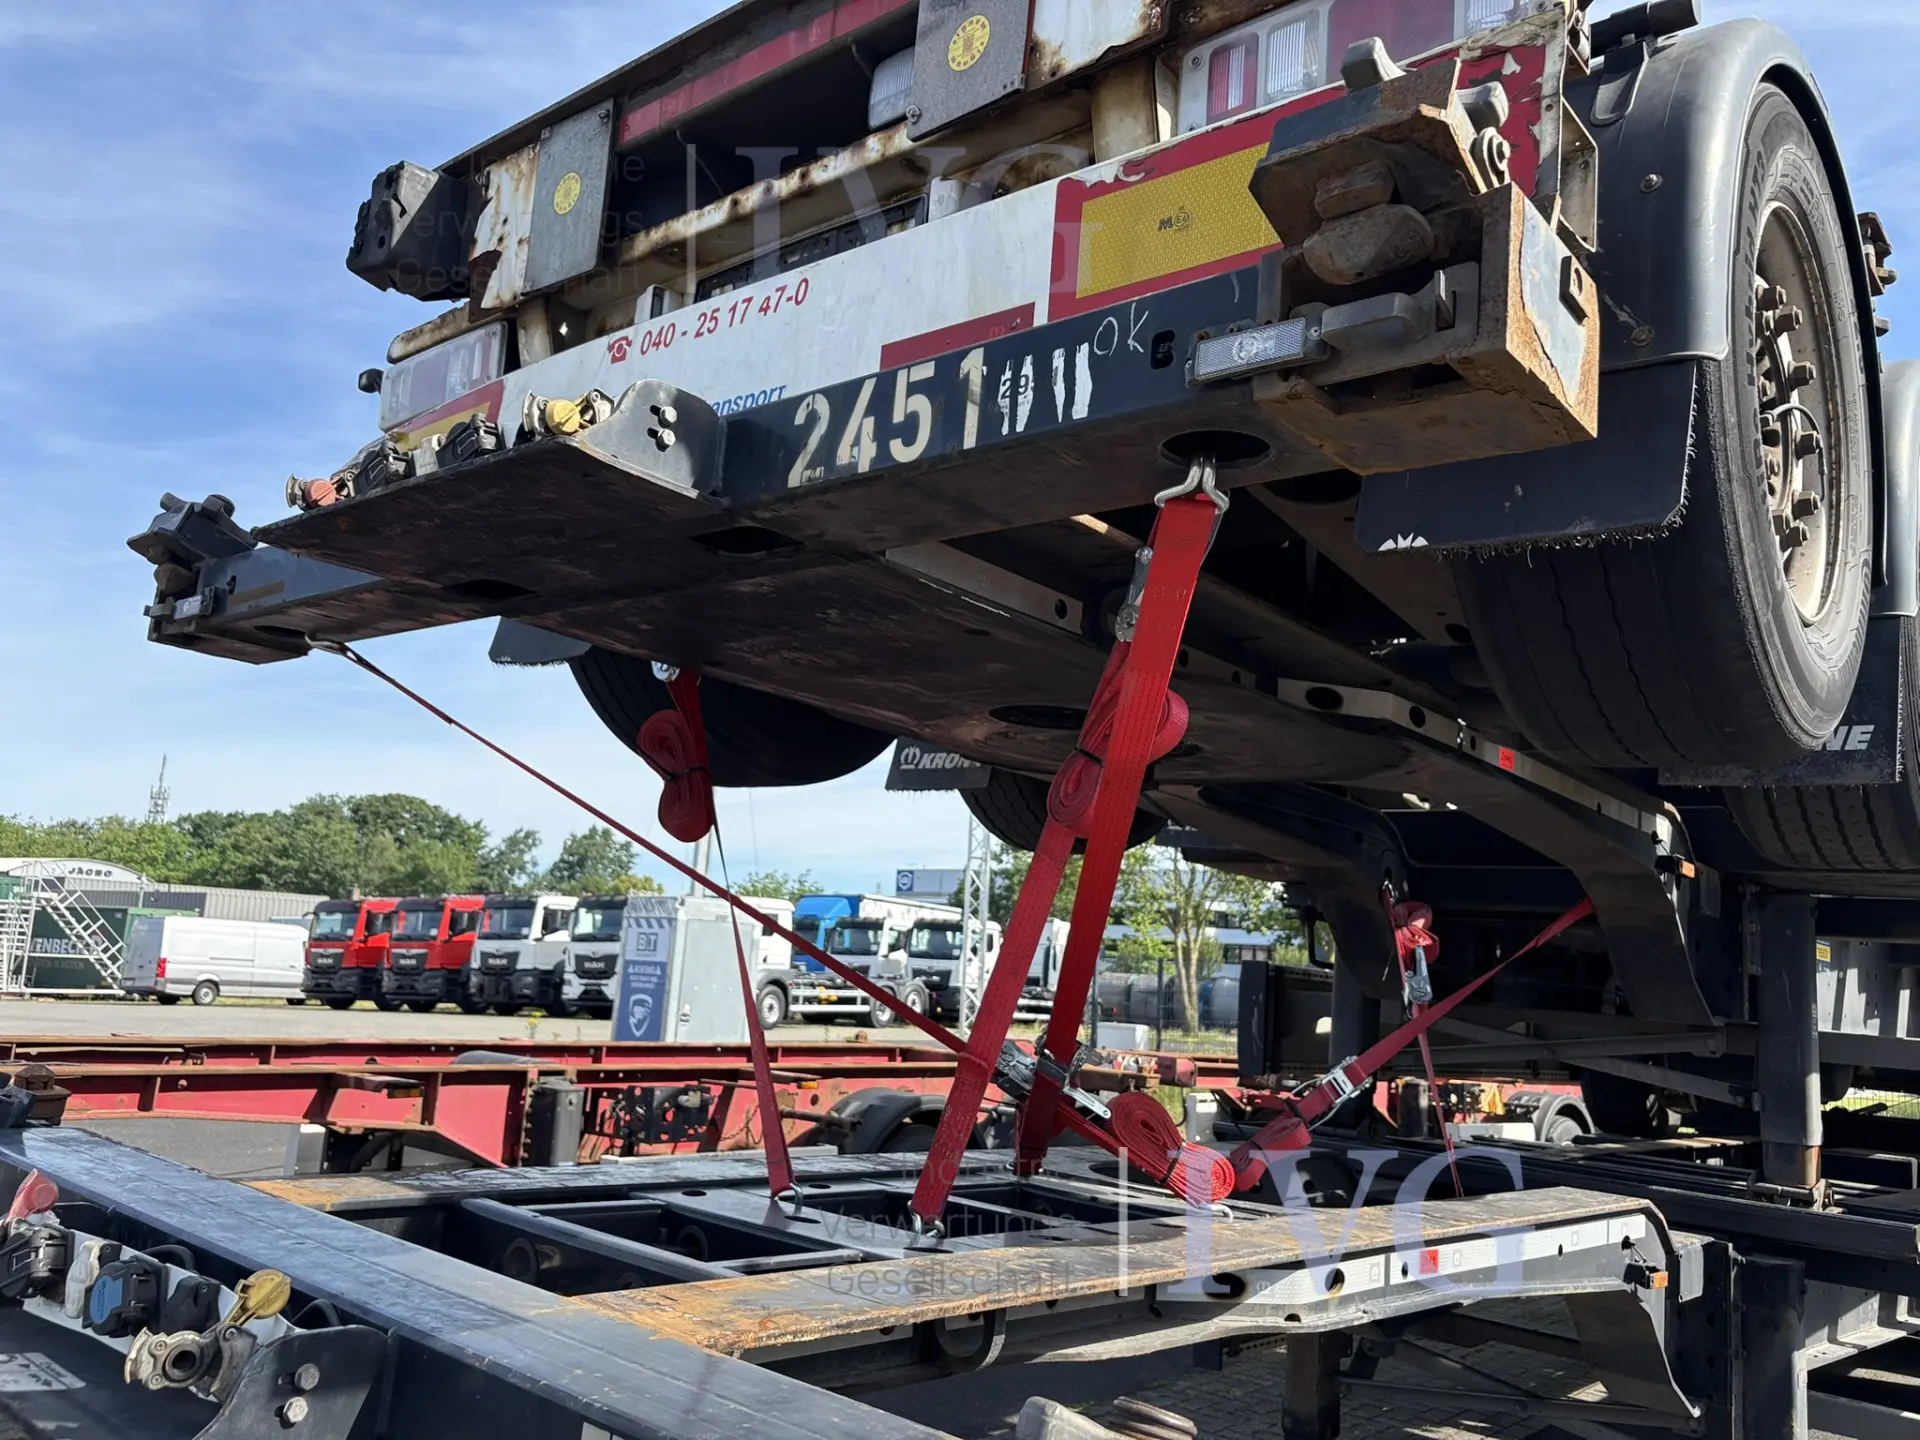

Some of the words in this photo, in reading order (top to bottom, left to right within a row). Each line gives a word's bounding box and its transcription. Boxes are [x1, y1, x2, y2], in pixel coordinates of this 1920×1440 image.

[640, 322, 676, 355] 040
[694, 307, 720, 339] 25
[728, 296, 753, 327] 17
[758, 277, 809, 316] 47-0
[787, 347, 985, 488] 2451
